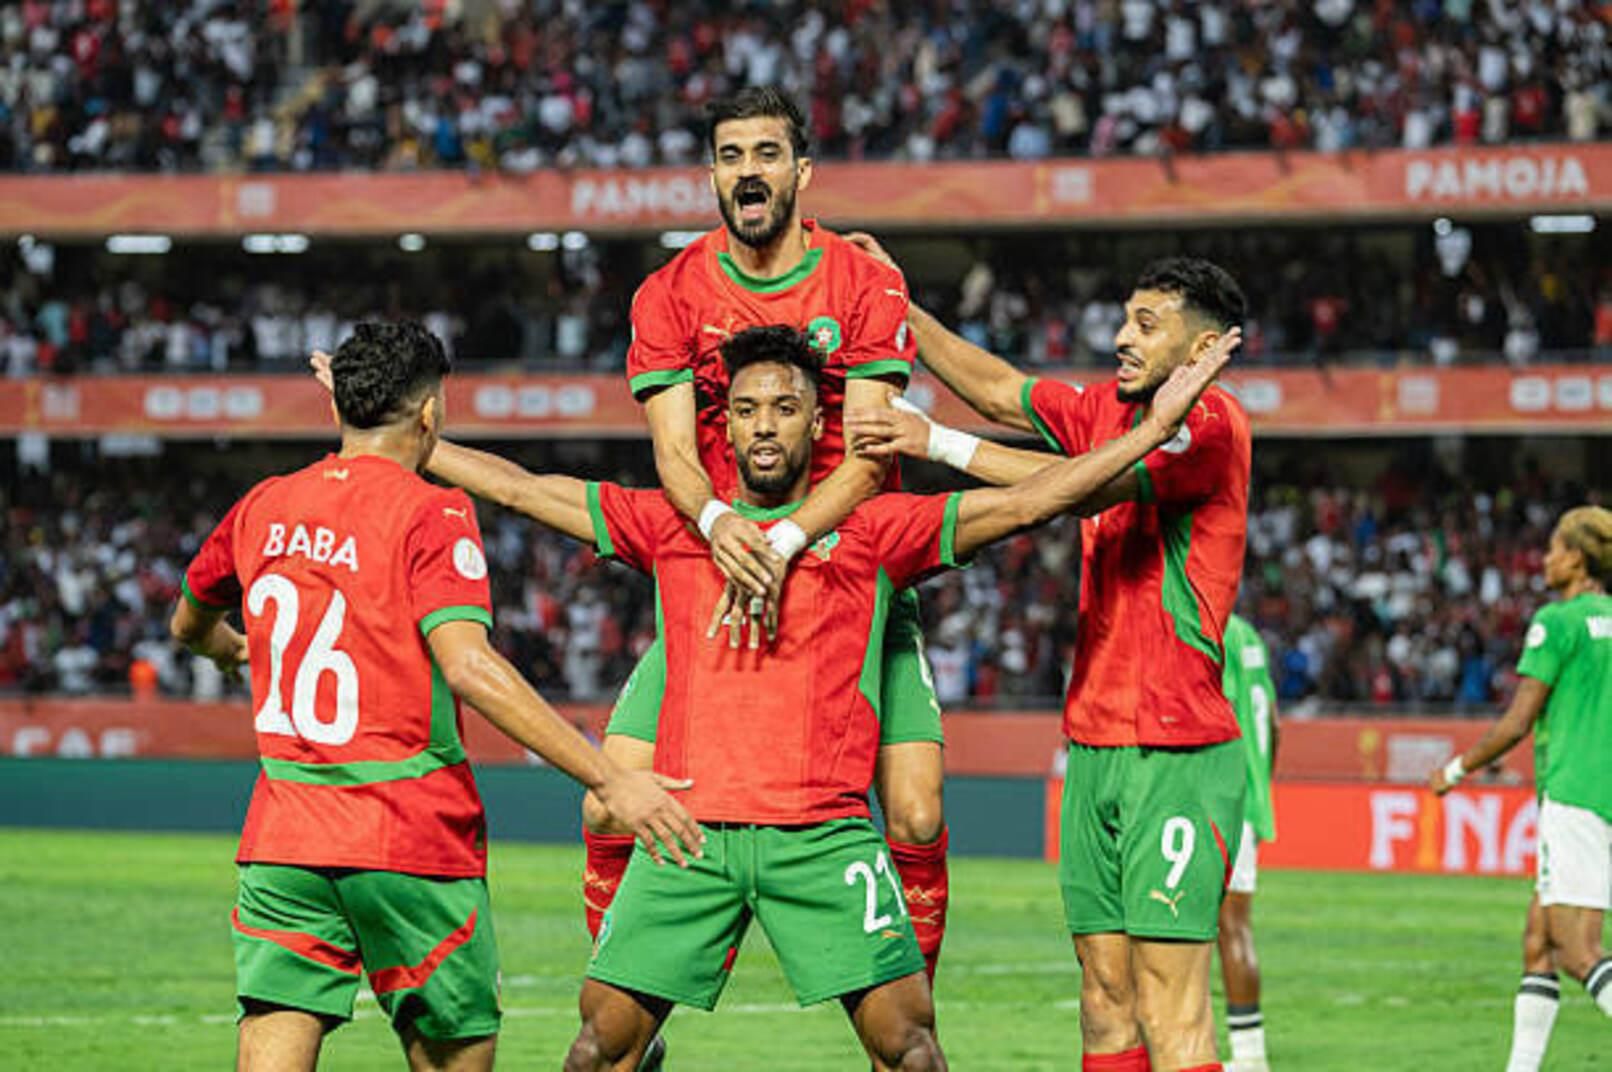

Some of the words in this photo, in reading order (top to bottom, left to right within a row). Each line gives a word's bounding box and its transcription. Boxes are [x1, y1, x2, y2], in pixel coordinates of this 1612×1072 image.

[572, 177, 718, 216] PAMOJ
[1406, 157, 1588, 200] PAMOJA
[263, 523, 358, 572] BABA
[248, 574, 359, 746] 26
[1162, 816, 1195, 888] 9
[845, 850, 907, 933] 21
